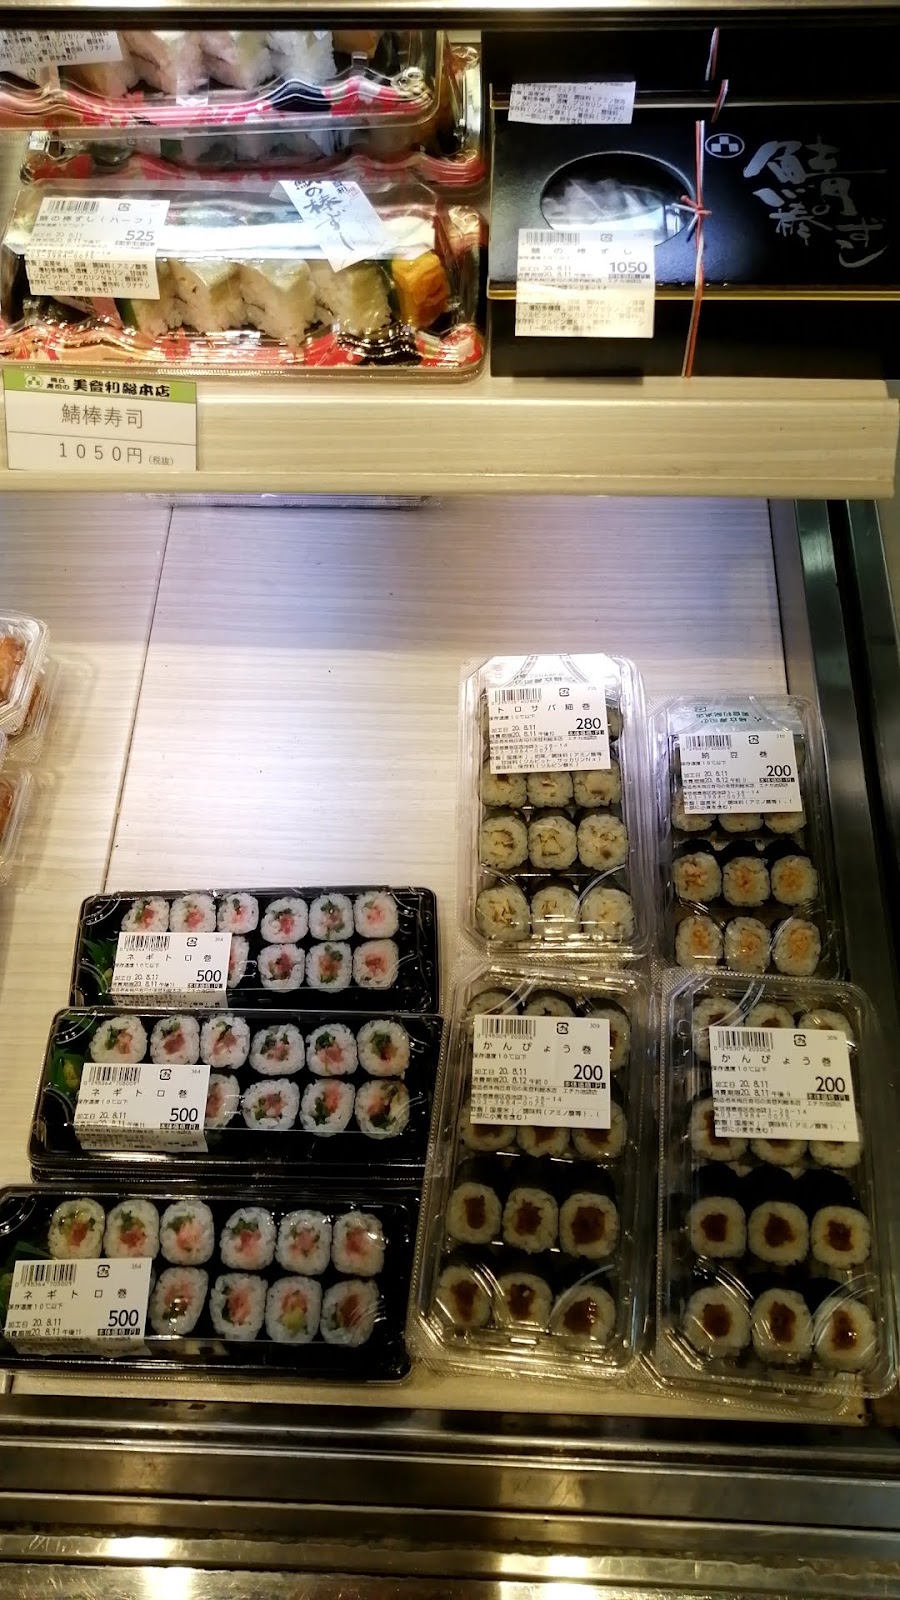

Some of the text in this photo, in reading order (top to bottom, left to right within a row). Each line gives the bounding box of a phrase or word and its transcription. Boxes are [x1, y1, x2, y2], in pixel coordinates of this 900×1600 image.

[124, 230, 154, 241] 525
[609, 261, 648, 273] 1050
[73, 379, 171, 398] 美登利総本店
[61, 403, 143, 429] 鯖棒寿司
[59, 442, 142, 464] 1050円
[575, 717, 601, 729] 280
[766, 765, 791, 776] 200
[127, 954, 212, 962] ネギトロ巻
[196, 969, 222, 982] 500
[483, 1041, 592, 1055] かんぴょう巻
[721, 1054, 832, 1067] かんぴょう巻
[512, 1067, 527, 1075] 8.11
[573, 1064, 603, 1081] 200
[753, 1080, 768, 1088] 8.11
[815, 1076, 846, 1093] 200
[91, 1088, 188, 1098] ネギトロ巻
[169, 1107, 198, 1122] 500
[23, 1288, 127, 1299] ネギトロ巻
[46, 1317, 61, 1326] 8.11
[108, 1309, 139, 1327] 500
